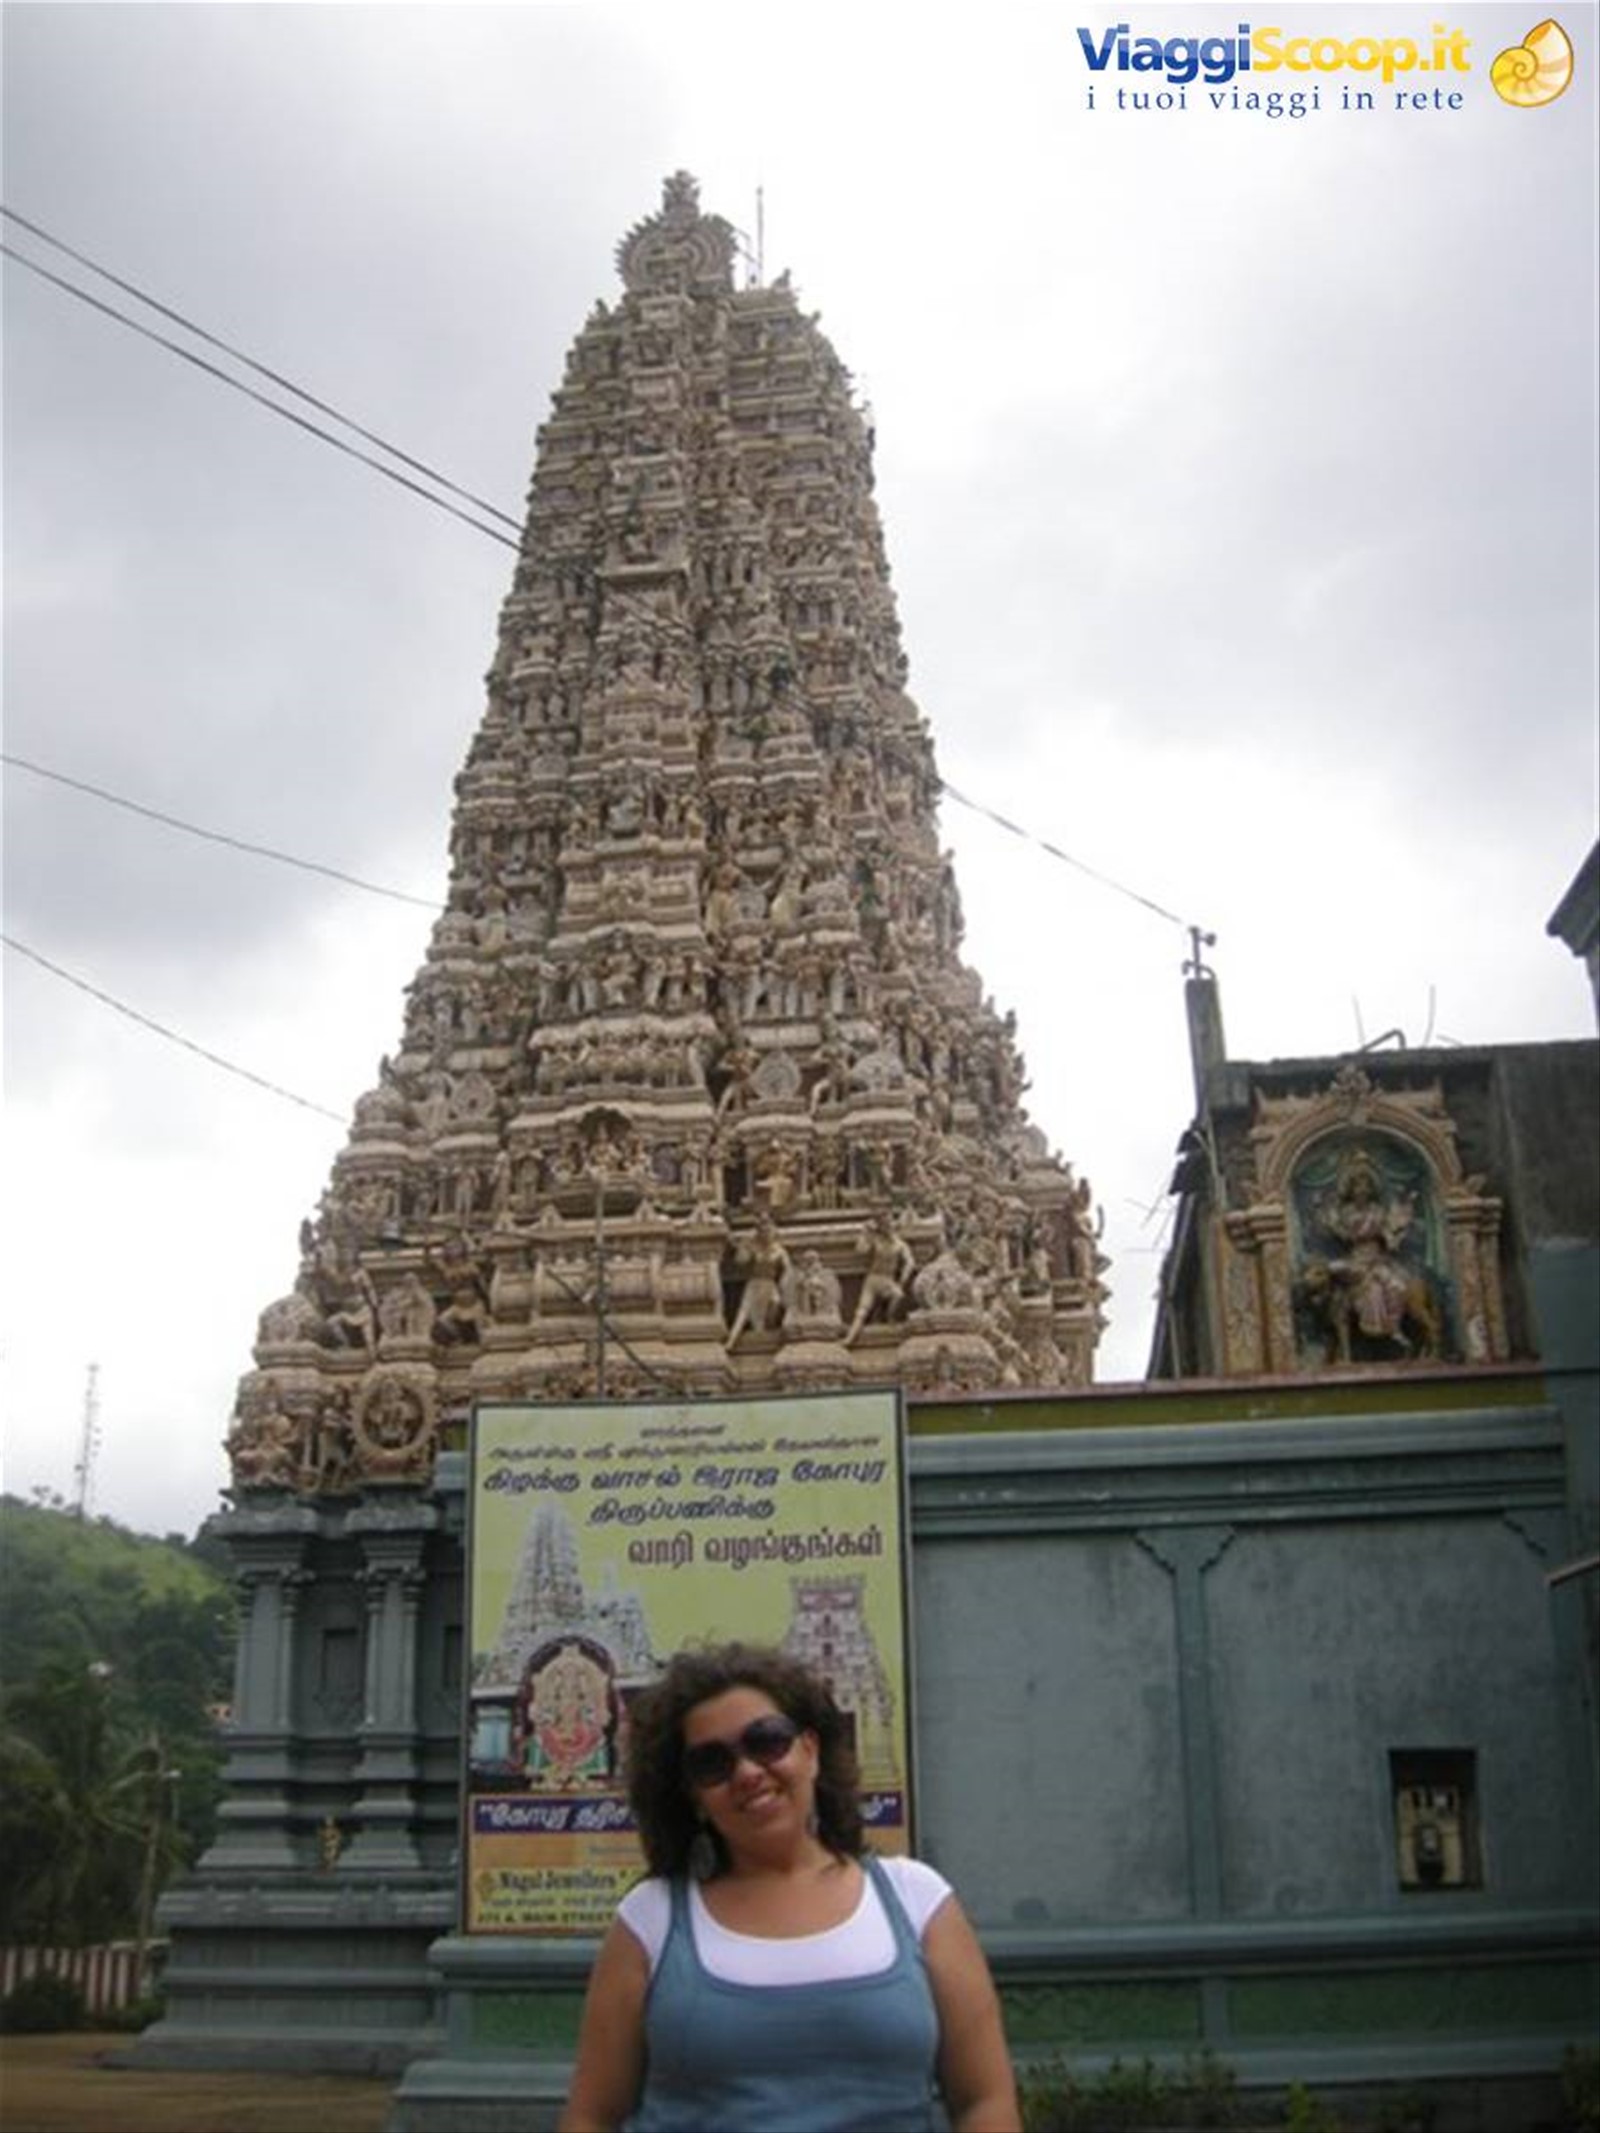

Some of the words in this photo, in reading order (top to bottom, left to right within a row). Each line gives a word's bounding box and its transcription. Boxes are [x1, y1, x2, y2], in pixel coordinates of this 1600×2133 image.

[484, 1468, 581, 1495] கிழக்கு
[591, 1464, 681, 1490] வாசல்
[792, 1459, 887, 1484] கோபுர
[587, 1496, 776, 1526] திருப்பணிக்கு
[628, 1530, 693, 1570] வாரி
[704, 1524, 883, 1570] வழங்குங்கள்
